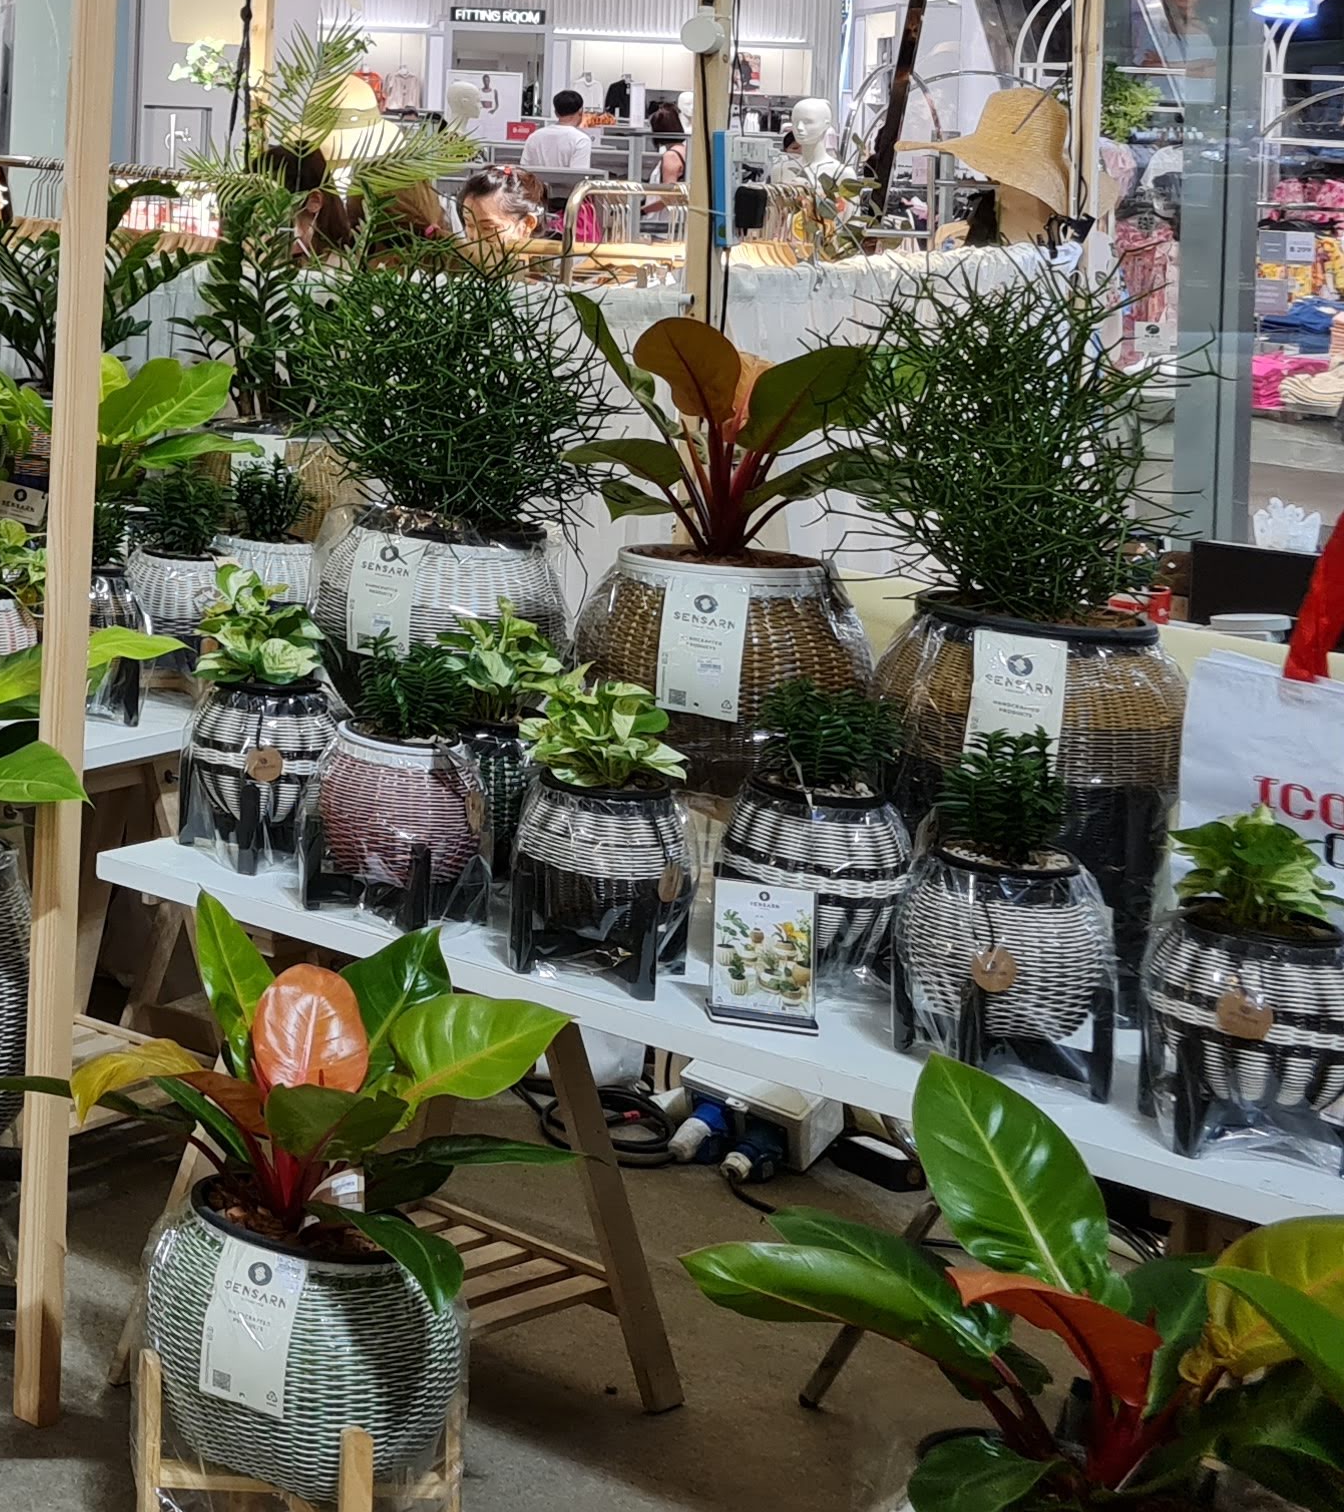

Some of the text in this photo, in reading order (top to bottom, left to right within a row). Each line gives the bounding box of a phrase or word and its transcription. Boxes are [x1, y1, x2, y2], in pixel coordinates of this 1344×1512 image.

[455, 8, 541, 25] FITTING ROOM
[361, 560, 410, 578] SENSARN
[673, 610, 736, 631] SENSARN
[223, 1279, 288, 1310] SENSARN
